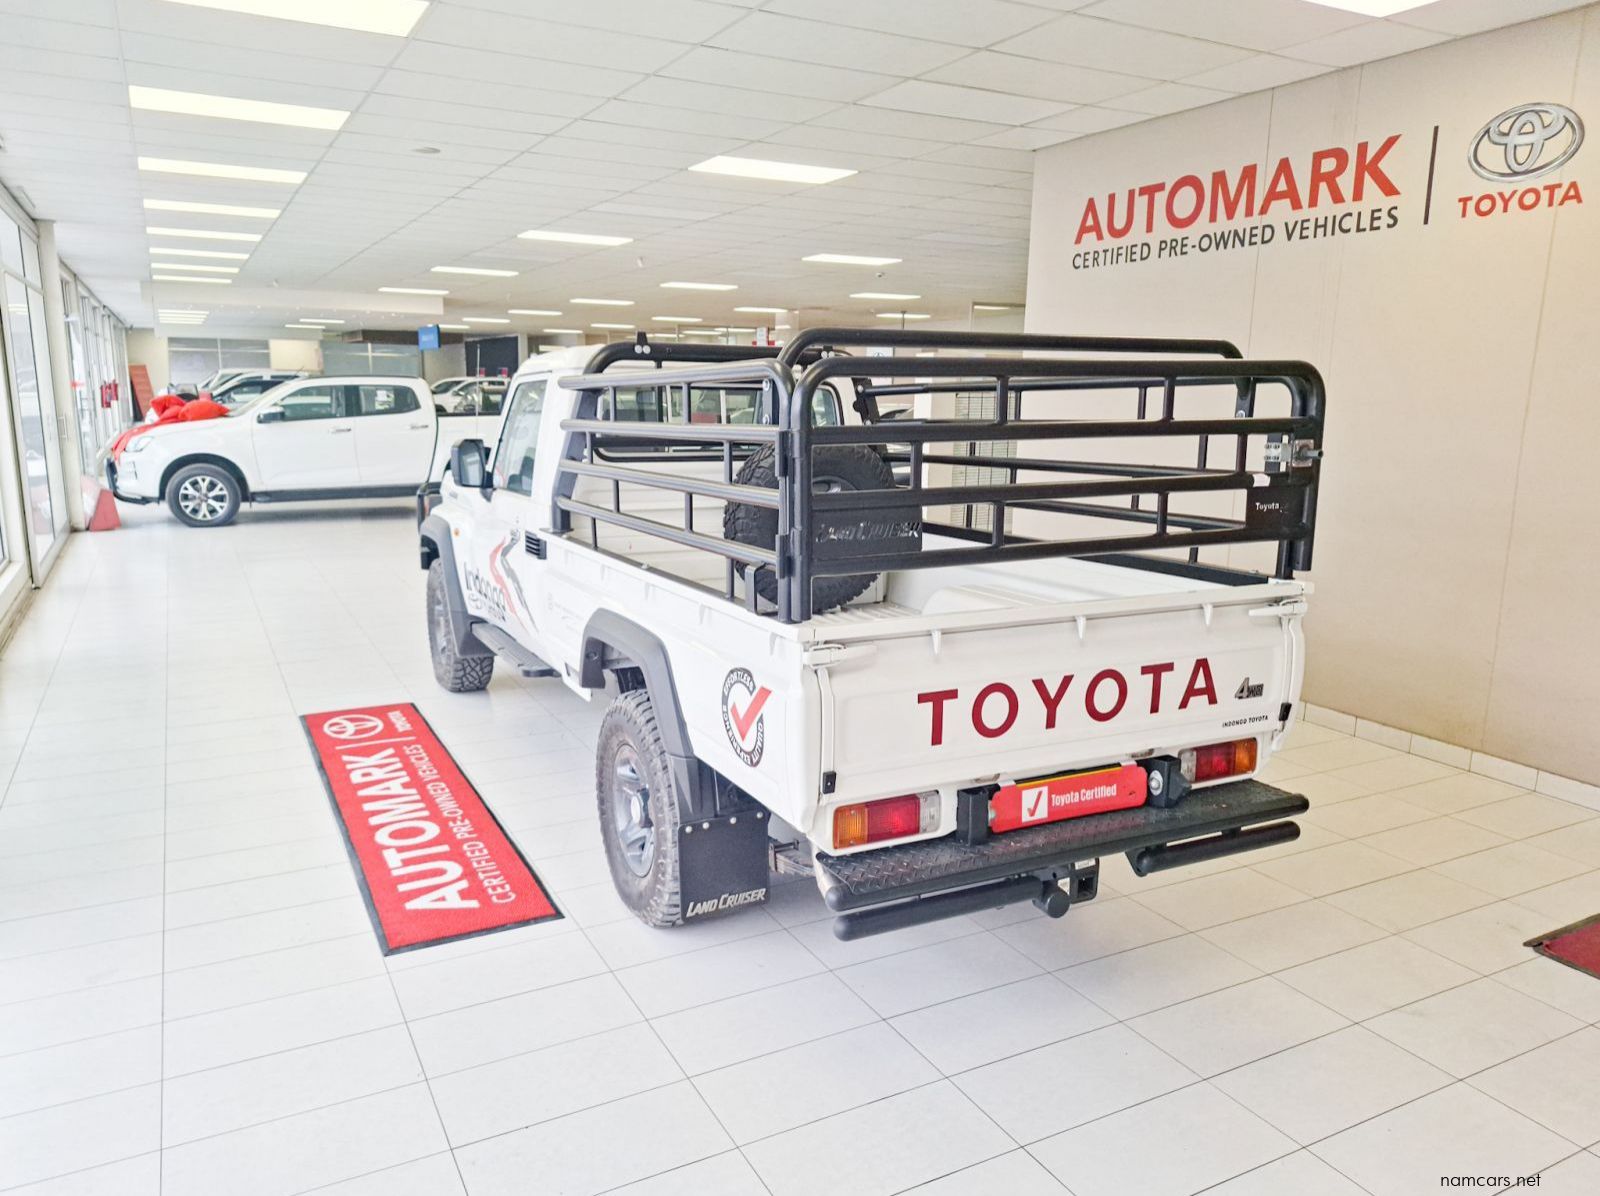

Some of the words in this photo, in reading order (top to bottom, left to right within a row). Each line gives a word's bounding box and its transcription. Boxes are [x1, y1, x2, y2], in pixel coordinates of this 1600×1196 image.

[1074, 134, 1402, 245] AUTOMARK
[1458, 181, 1583, 218] TOYOTA
[1072, 242, 1151, 270] CERTIFIED
[1158, 224, 1275, 258] PRE-OWNED
[1284, 205, 1399, 242] VEHICLES
[917, 657, 1218, 746] TOYOTA
[1248, 715, 1269, 723] TOYOTA
[403, 743, 441, 782] VEHICLES
[426, 781, 479, 841] PRE-OWNED
[1051, 791, 1080, 807] Toyota
[1080, 783, 1117, 801] Certified
[341, 747, 481, 910] AUTOMARK
[462, 841, 517, 904] CERTIFIED
[686, 899, 718, 918] LAND
[718, 887, 767, 909] CRUISER
